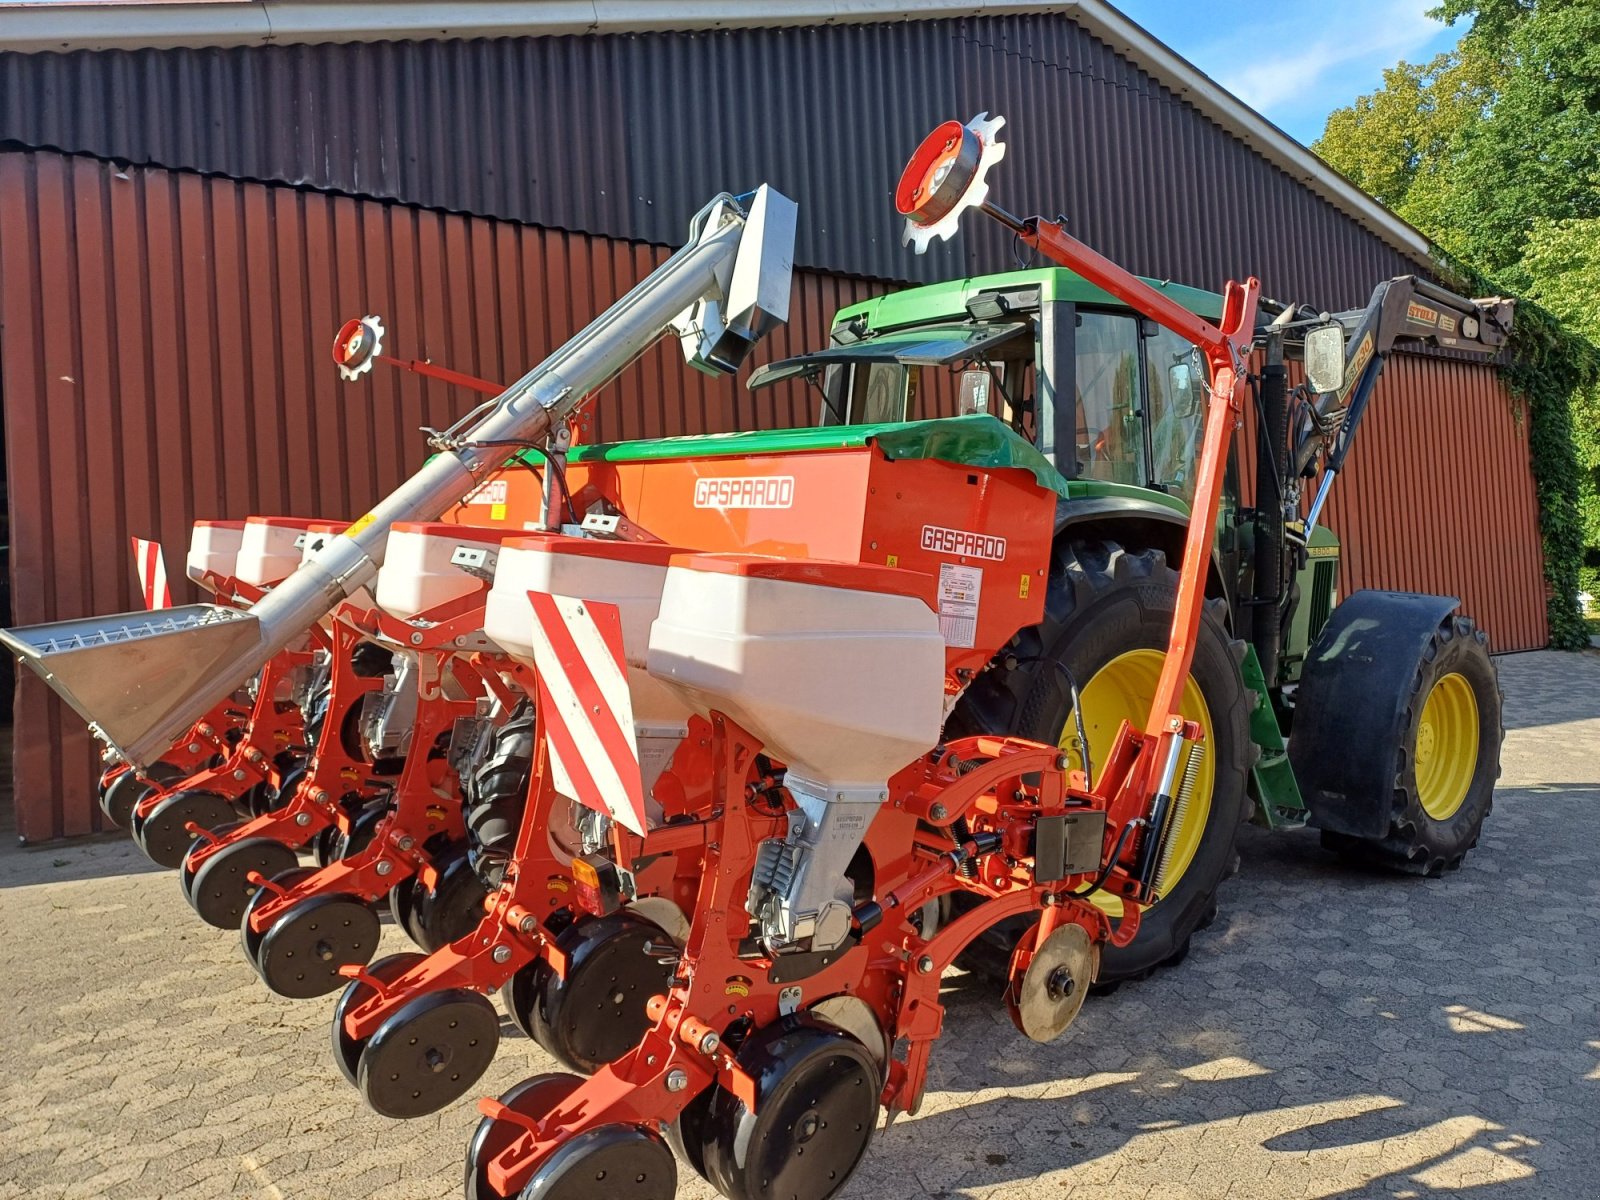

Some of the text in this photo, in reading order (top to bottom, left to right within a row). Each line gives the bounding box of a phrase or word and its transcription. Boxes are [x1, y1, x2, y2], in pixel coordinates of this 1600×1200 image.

[1408, 304, 1436, 322] STOLL
[695, 479, 793, 506] GASPARDO
[921, 526, 1005, 560] GASPARDO
